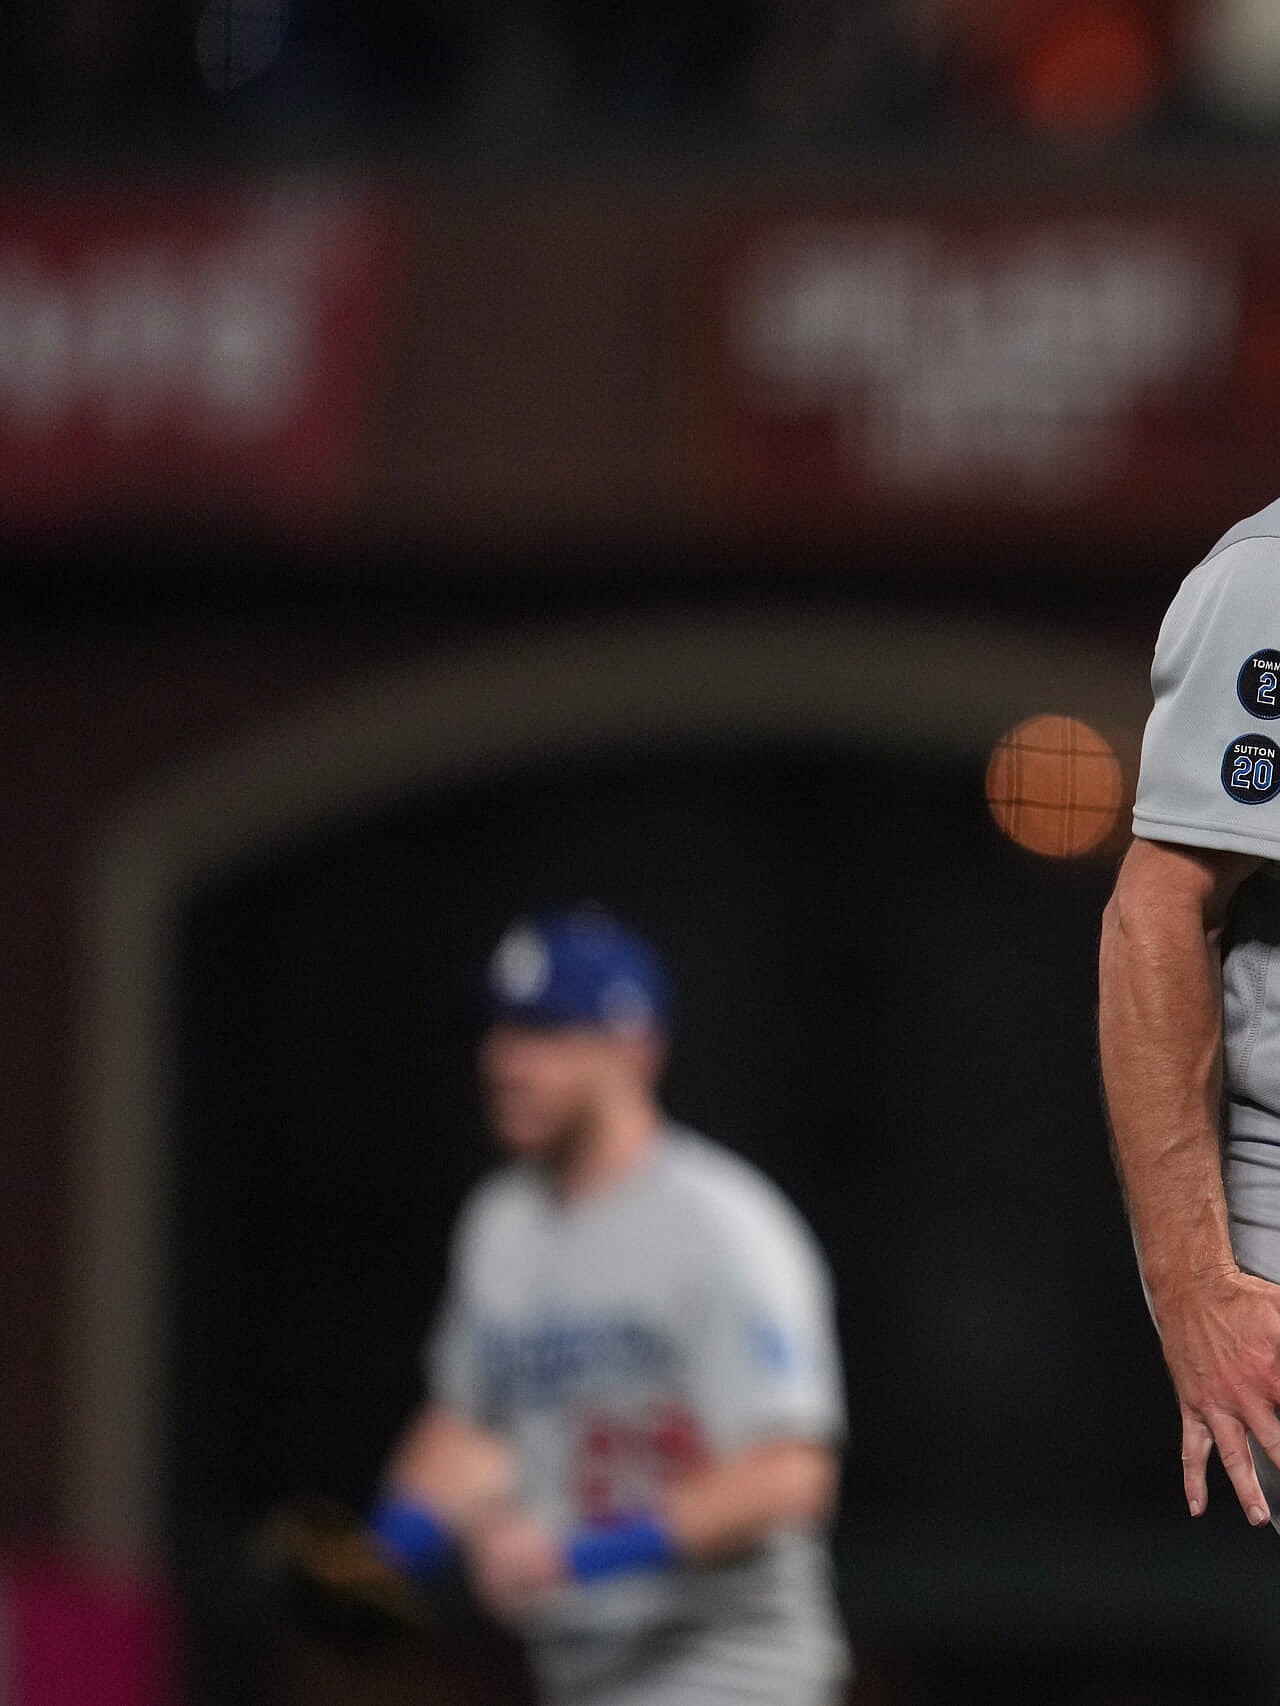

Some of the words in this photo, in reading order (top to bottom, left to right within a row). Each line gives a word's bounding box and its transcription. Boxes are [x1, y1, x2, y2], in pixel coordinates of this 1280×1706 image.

[1257, 671, 1278, 706] 2
[1233, 744, 1275, 758] SUTTON
[1231, 755, 1274, 791] 20
